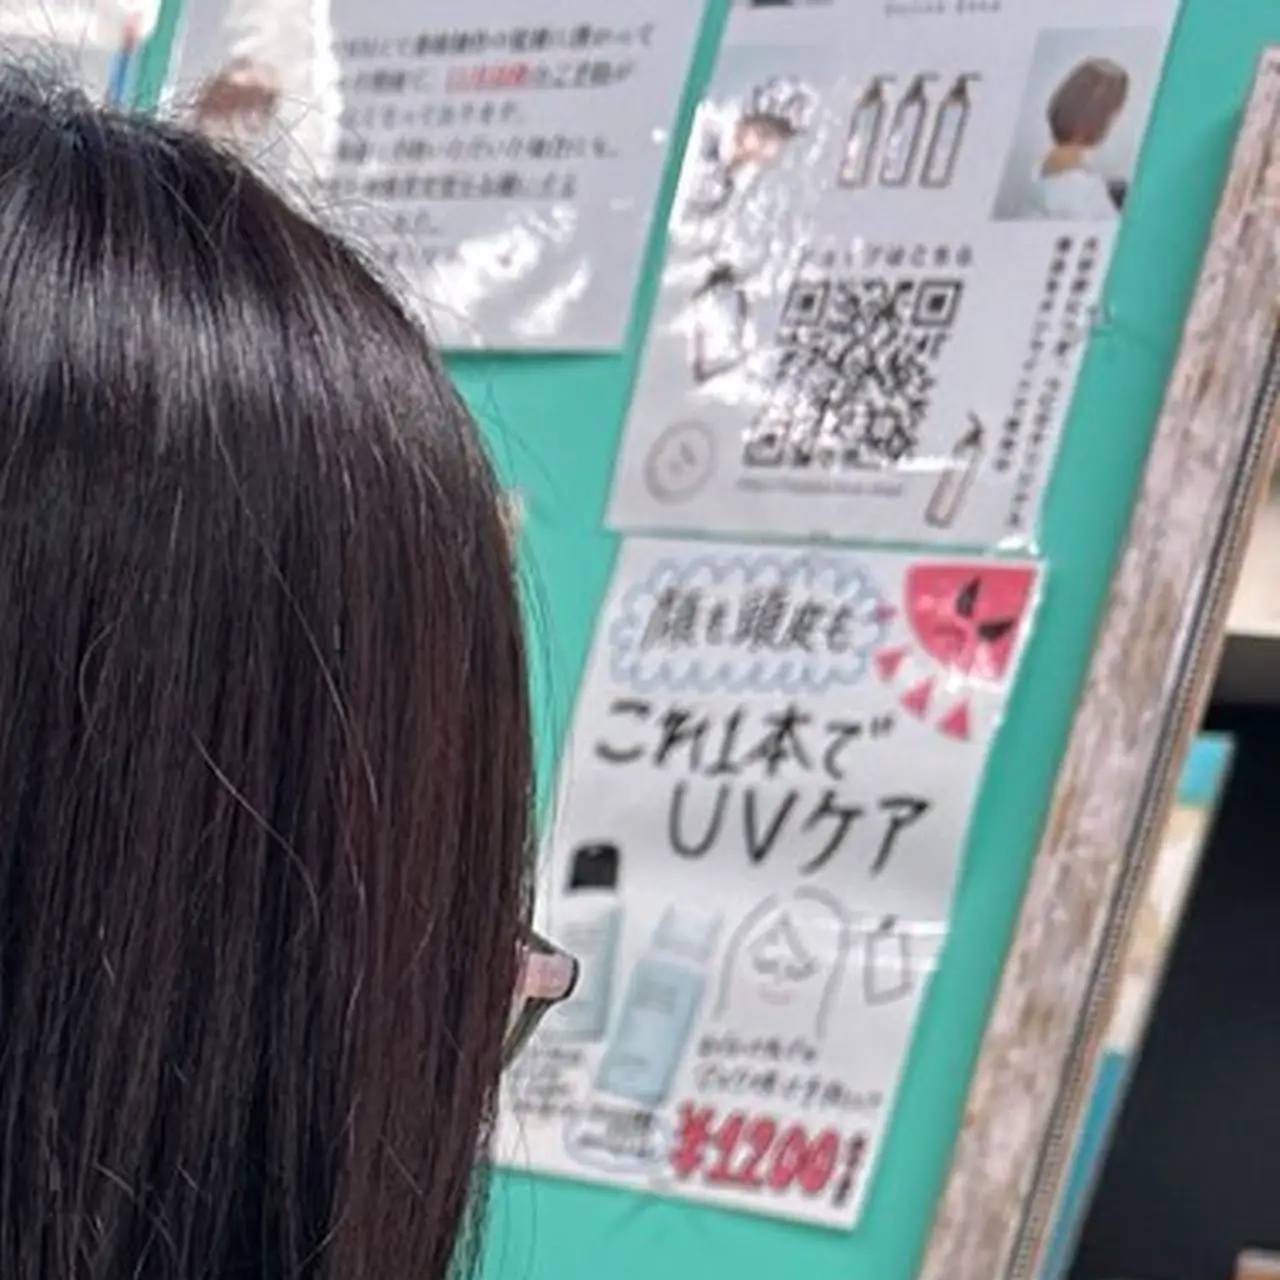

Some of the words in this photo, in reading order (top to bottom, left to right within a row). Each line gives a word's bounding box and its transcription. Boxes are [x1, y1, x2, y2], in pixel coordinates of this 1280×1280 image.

[594, 697, 896, 779] これ1本で
[668, 781, 930, 877] UVケア
